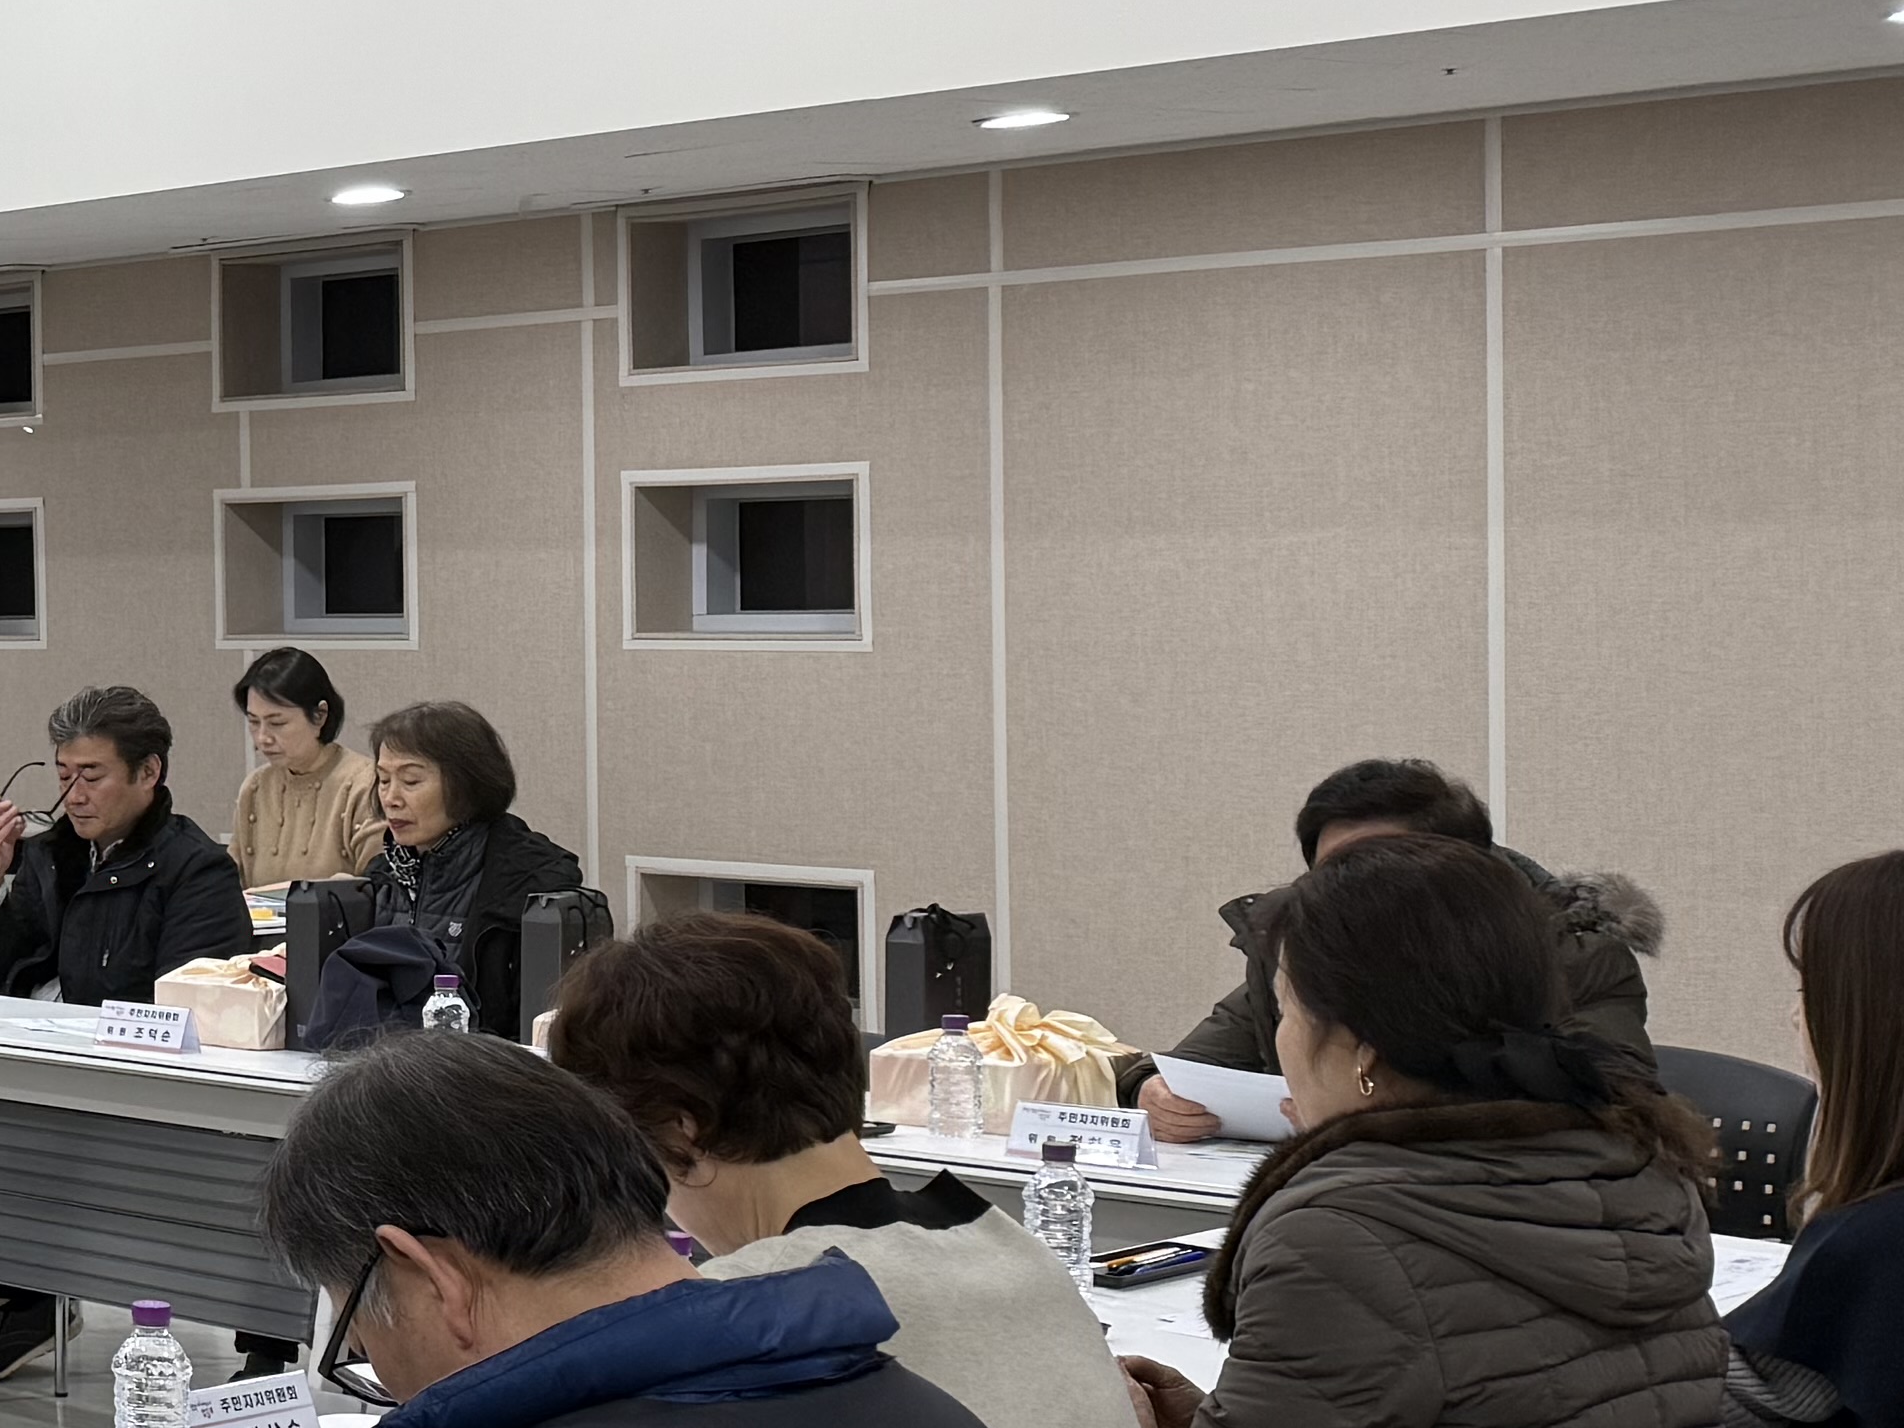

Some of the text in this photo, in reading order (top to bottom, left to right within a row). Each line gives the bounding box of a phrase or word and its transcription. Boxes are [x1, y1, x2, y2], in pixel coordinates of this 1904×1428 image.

[133, 1026, 171, 1043] 조덕순
[1058, 1111, 1132, 1129] 주민자치위원회
[219, 1384, 299, 1414] 주민자치위원회
